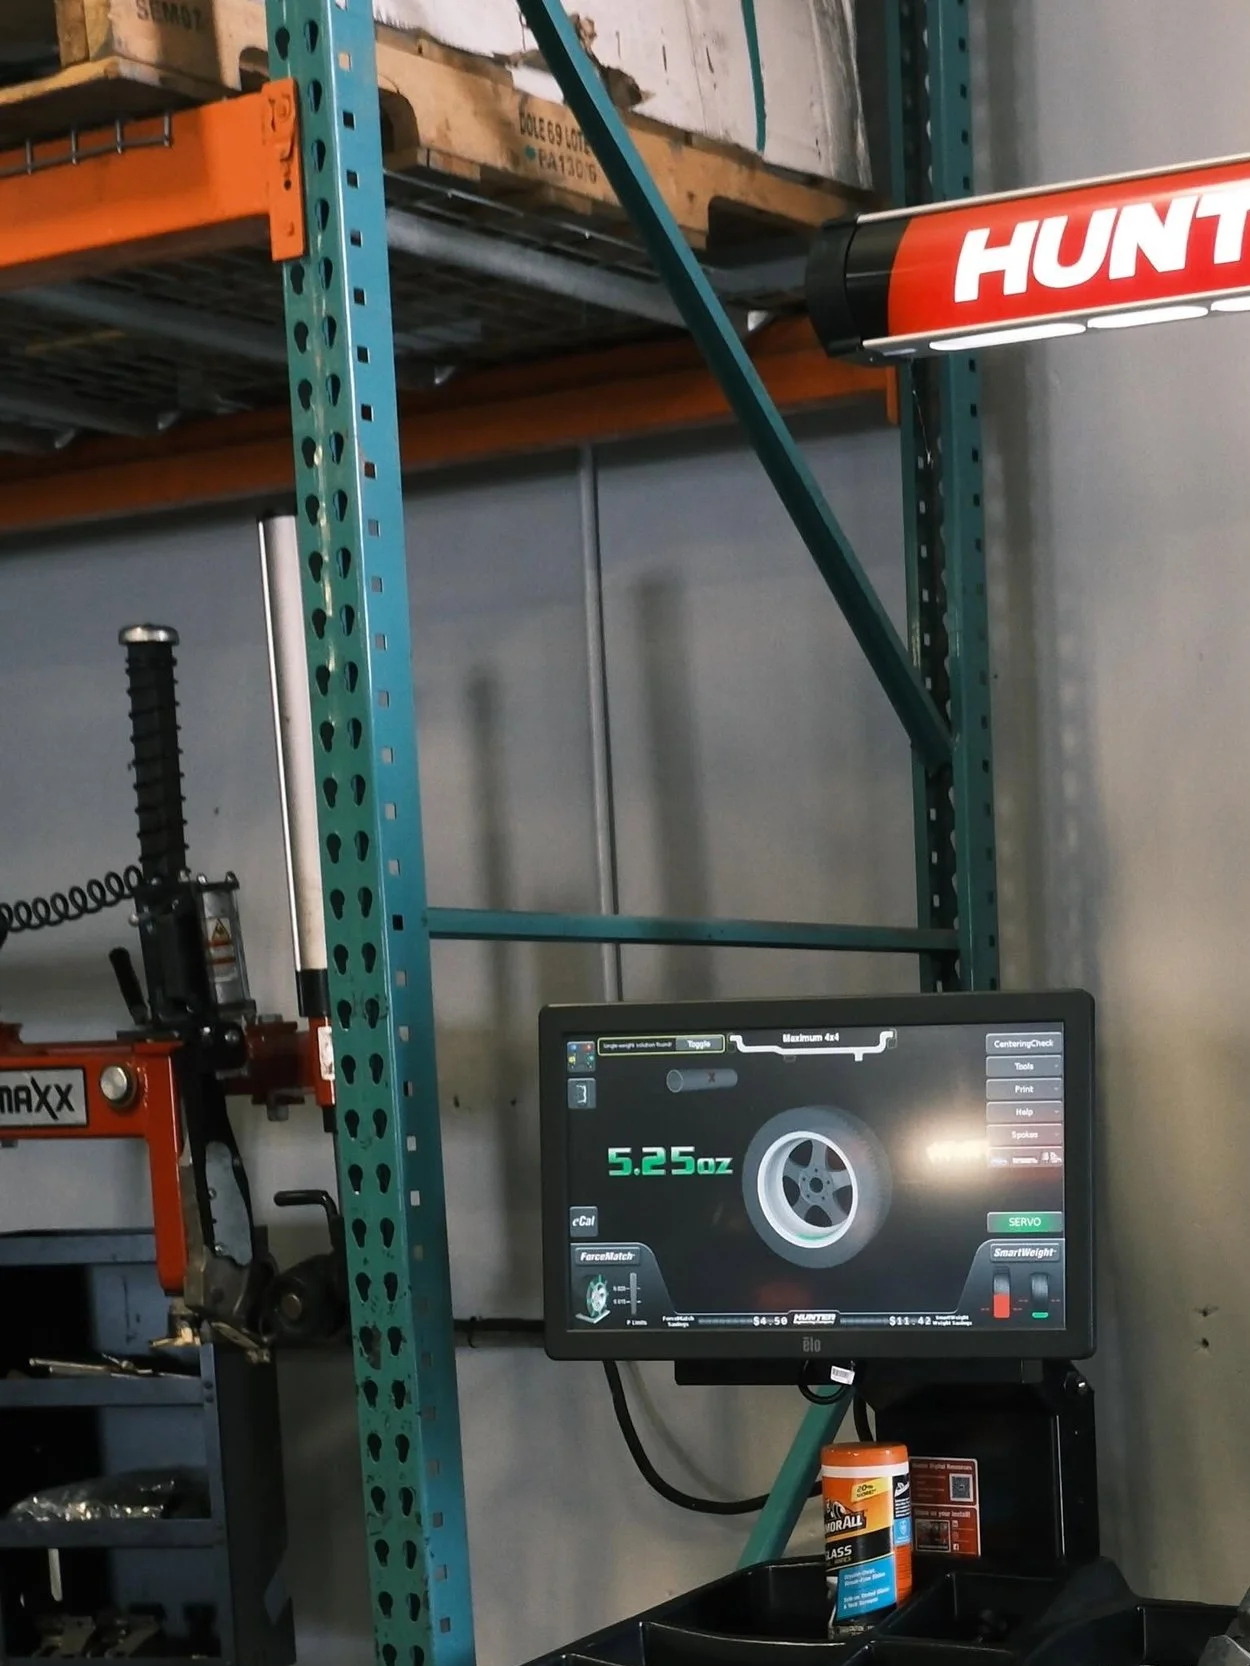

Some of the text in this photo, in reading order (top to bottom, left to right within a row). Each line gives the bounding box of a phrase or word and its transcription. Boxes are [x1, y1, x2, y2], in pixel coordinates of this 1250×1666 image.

[994, 1039, 1054, 1049] CenteringCheck
[1014, 1062, 1034, 1071] Tools
[1014, 1085, 1034, 1093] Print
[1015, 1108, 1033, 1117] Help
[572, 1215, 595, 1227] eCal
[1008, 1217, 1042, 1227] SERVO
[580, 1251, 635, 1261] ForceMatch
[993, 1248, 1056, 1259] SmartWeight
[753, 1316, 788, 1327] $4.50
[793, 1313, 836, 1322] HUNTER
[889, 1315, 932, 1327] $11.42
[826, 1544, 852, 1560] LASS
